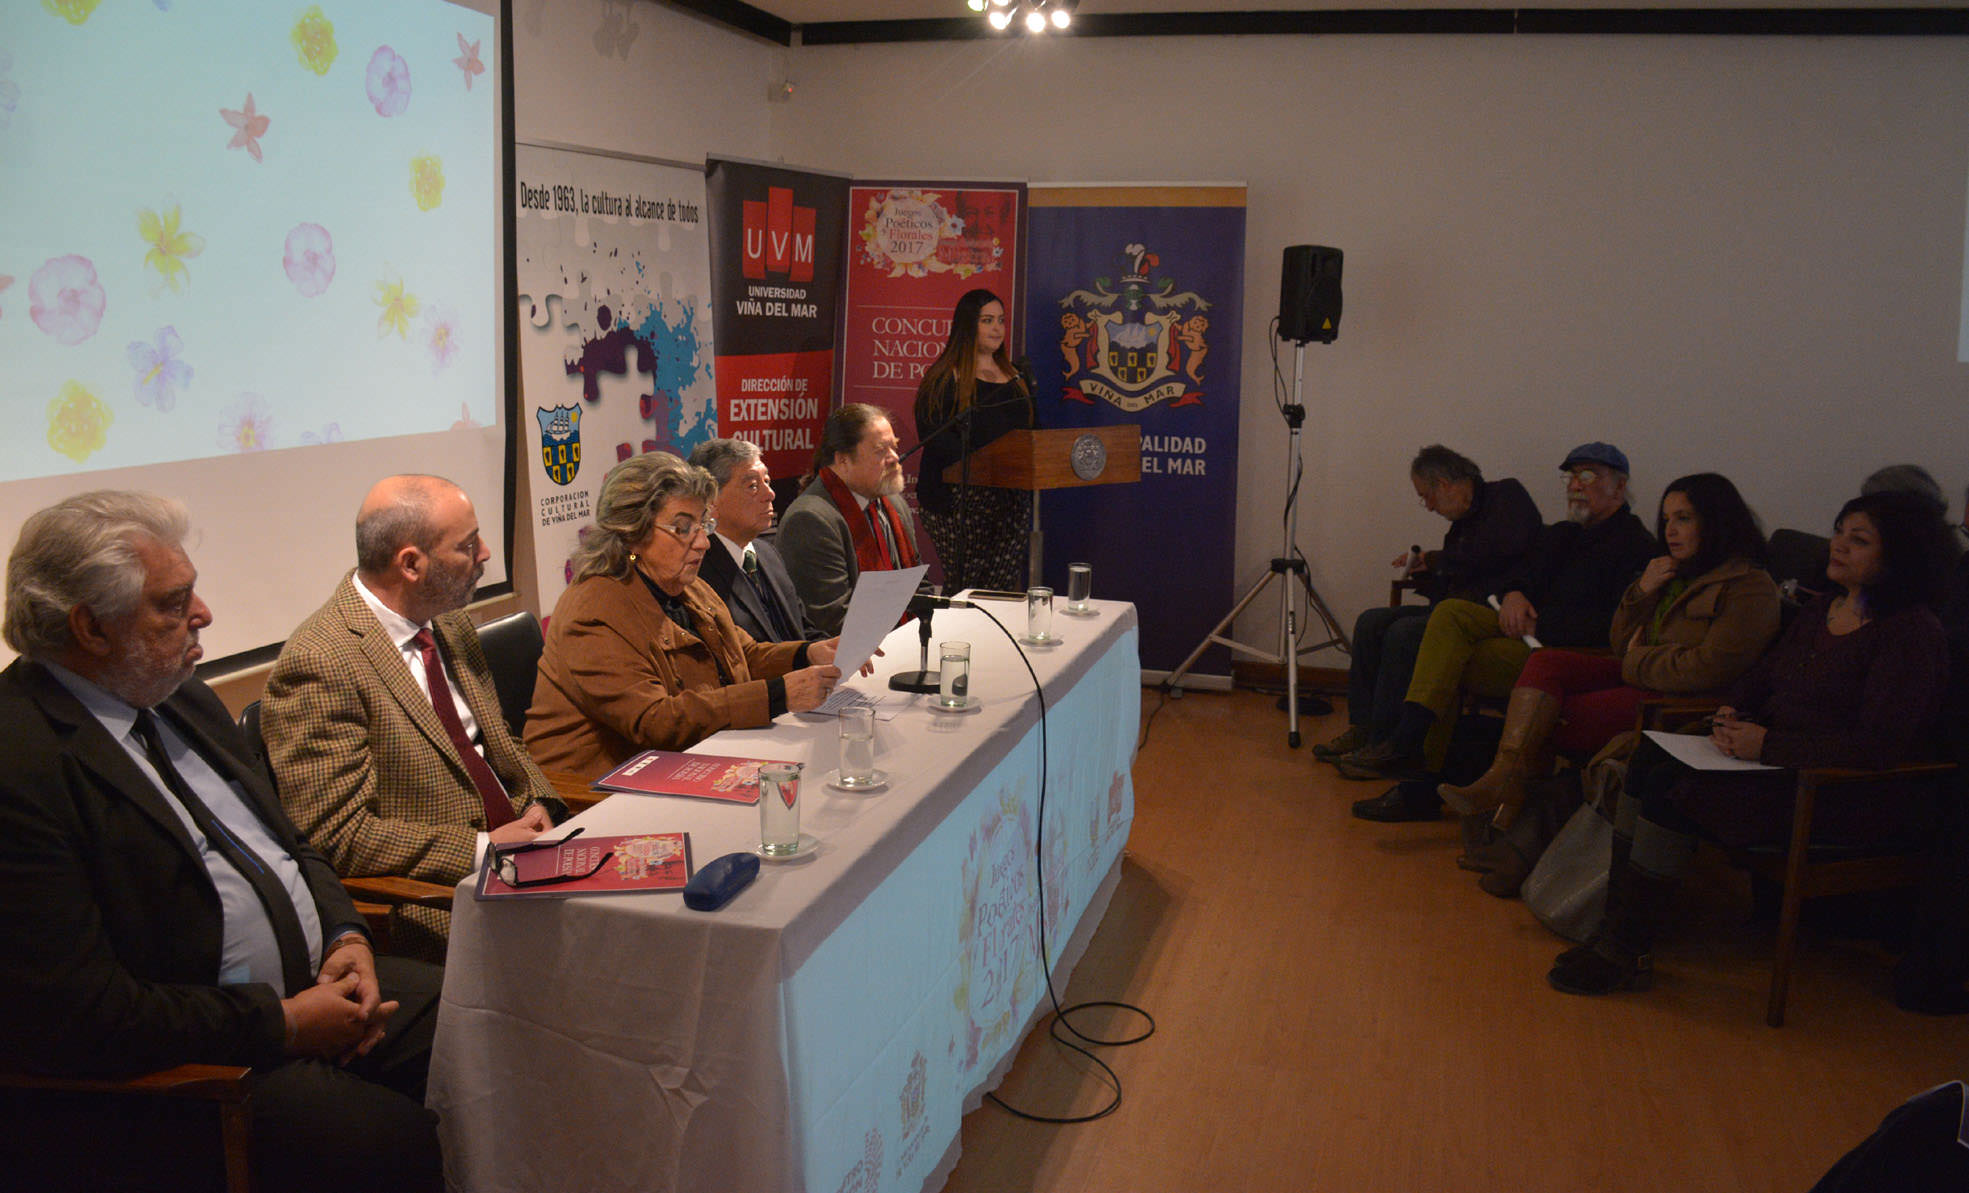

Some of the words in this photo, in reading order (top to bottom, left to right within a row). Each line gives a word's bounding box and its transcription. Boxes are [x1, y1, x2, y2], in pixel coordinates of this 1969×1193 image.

[520, 181, 550, 211] Desde
[553, 184, 579, 216] 1963,
[580, 188, 589, 213] la
[592, 190, 622, 217] cultura
[625, 194, 633, 217] al
[635, 194, 664, 221] alcance
[667, 198, 676, 221] de
[678, 199, 699, 223] todos
[885, 217, 933, 229] Poéticos
[889, 228, 933, 241] Florales
[747, 228, 813, 264] UVM
[890, 240, 924, 254] 2017
[748, 285, 807, 300] UNIVERSIDAD
[736, 298, 763, 316] VIÑA
[765, 302, 789, 317] DEL
[791, 303, 817, 318] MAR
[873, 361, 903, 379] DE
[741, 375, 794, 393] DIRECCIÓN
[795, 378, 809, 392] DE
[1143, 385, 1175, 405] MAR
[729, 392, 819, 422] EXTENSIÓN
[1140, 435, 1207, 454] ALIDAD
[1141, 457, 1163, 474] EL
[1167, 457, 1206, 476] MAR
[541, 500, 590, 517] CULTURAL
[542, 517, 551, 527] DE
[566, 512, 577, 521] DEL
[578, 508, 590, 518] MAR
